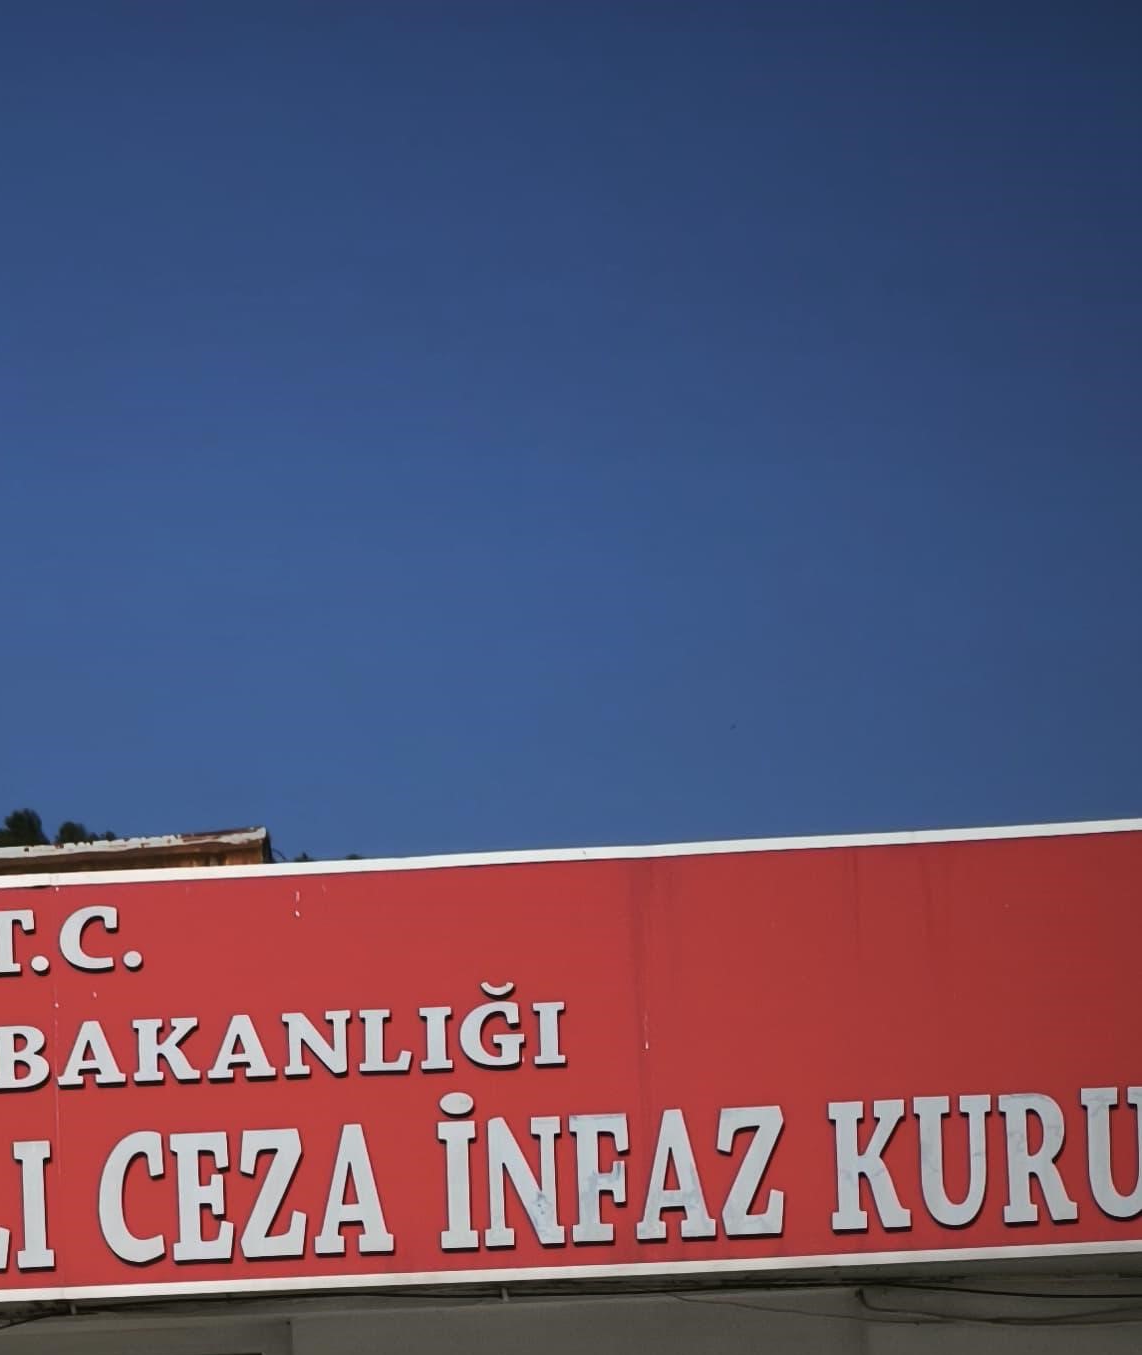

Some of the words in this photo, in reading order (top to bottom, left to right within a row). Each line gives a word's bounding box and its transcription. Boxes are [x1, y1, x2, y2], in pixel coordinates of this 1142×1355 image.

[98, 1123, 394, 1263] CEZA
[438, 1092, 784, 1249] İNFAZ
[827, 1086, 1142, 1230] KURU
